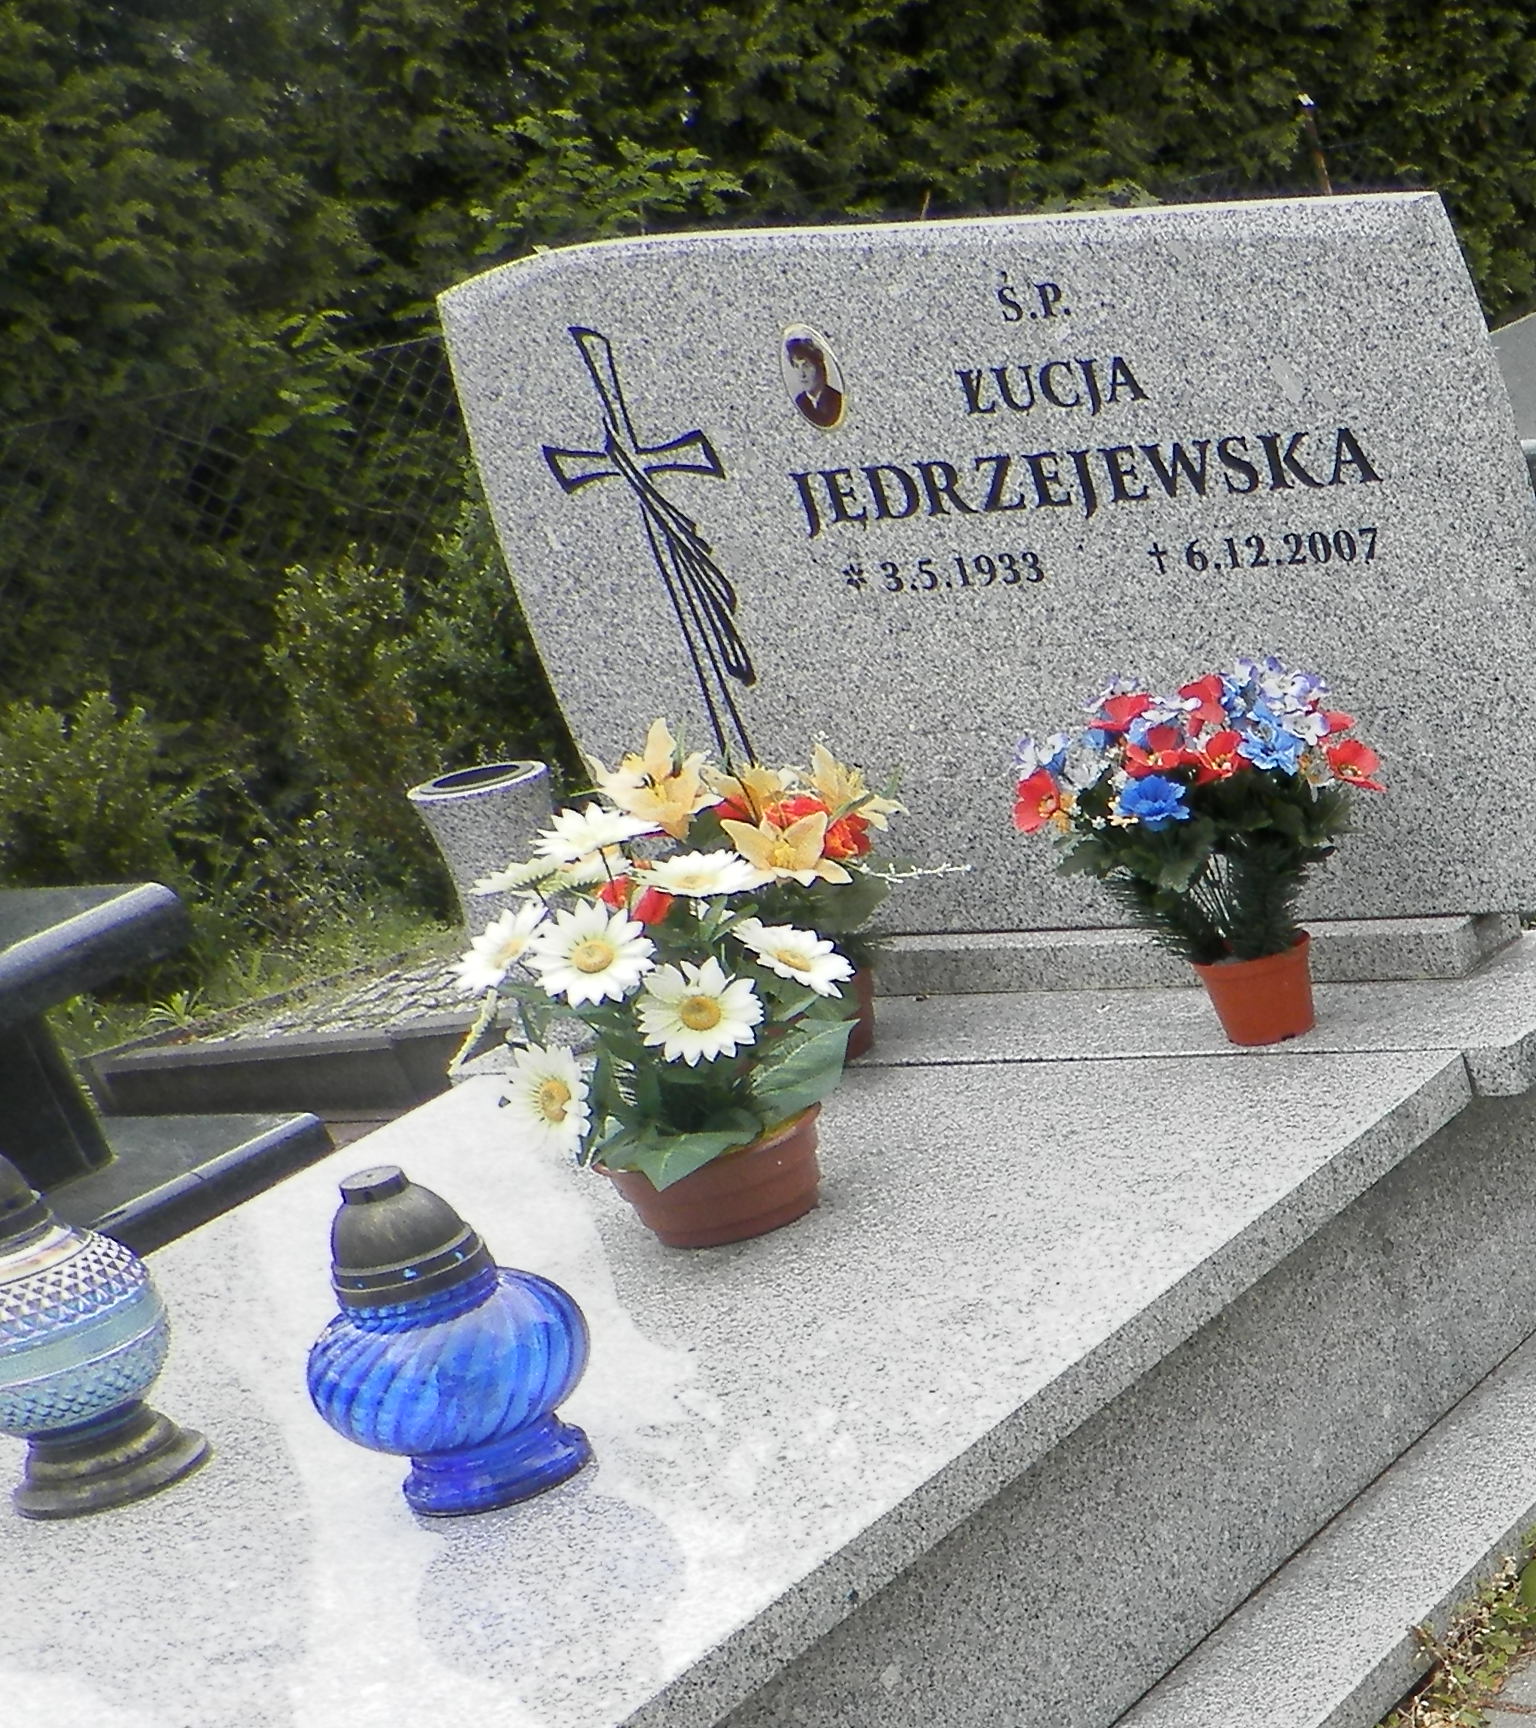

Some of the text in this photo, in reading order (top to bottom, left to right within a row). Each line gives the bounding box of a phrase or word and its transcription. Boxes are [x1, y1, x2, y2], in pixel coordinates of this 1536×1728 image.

[954, 356, 1150, 417] ŁUCJA
[788, 428, 1383, 538] JĘDRZEJEWSKA
[880, 552, 1045, 592] 3.5.1933
[1185, 527, 1377, 572] 6.12.2007
